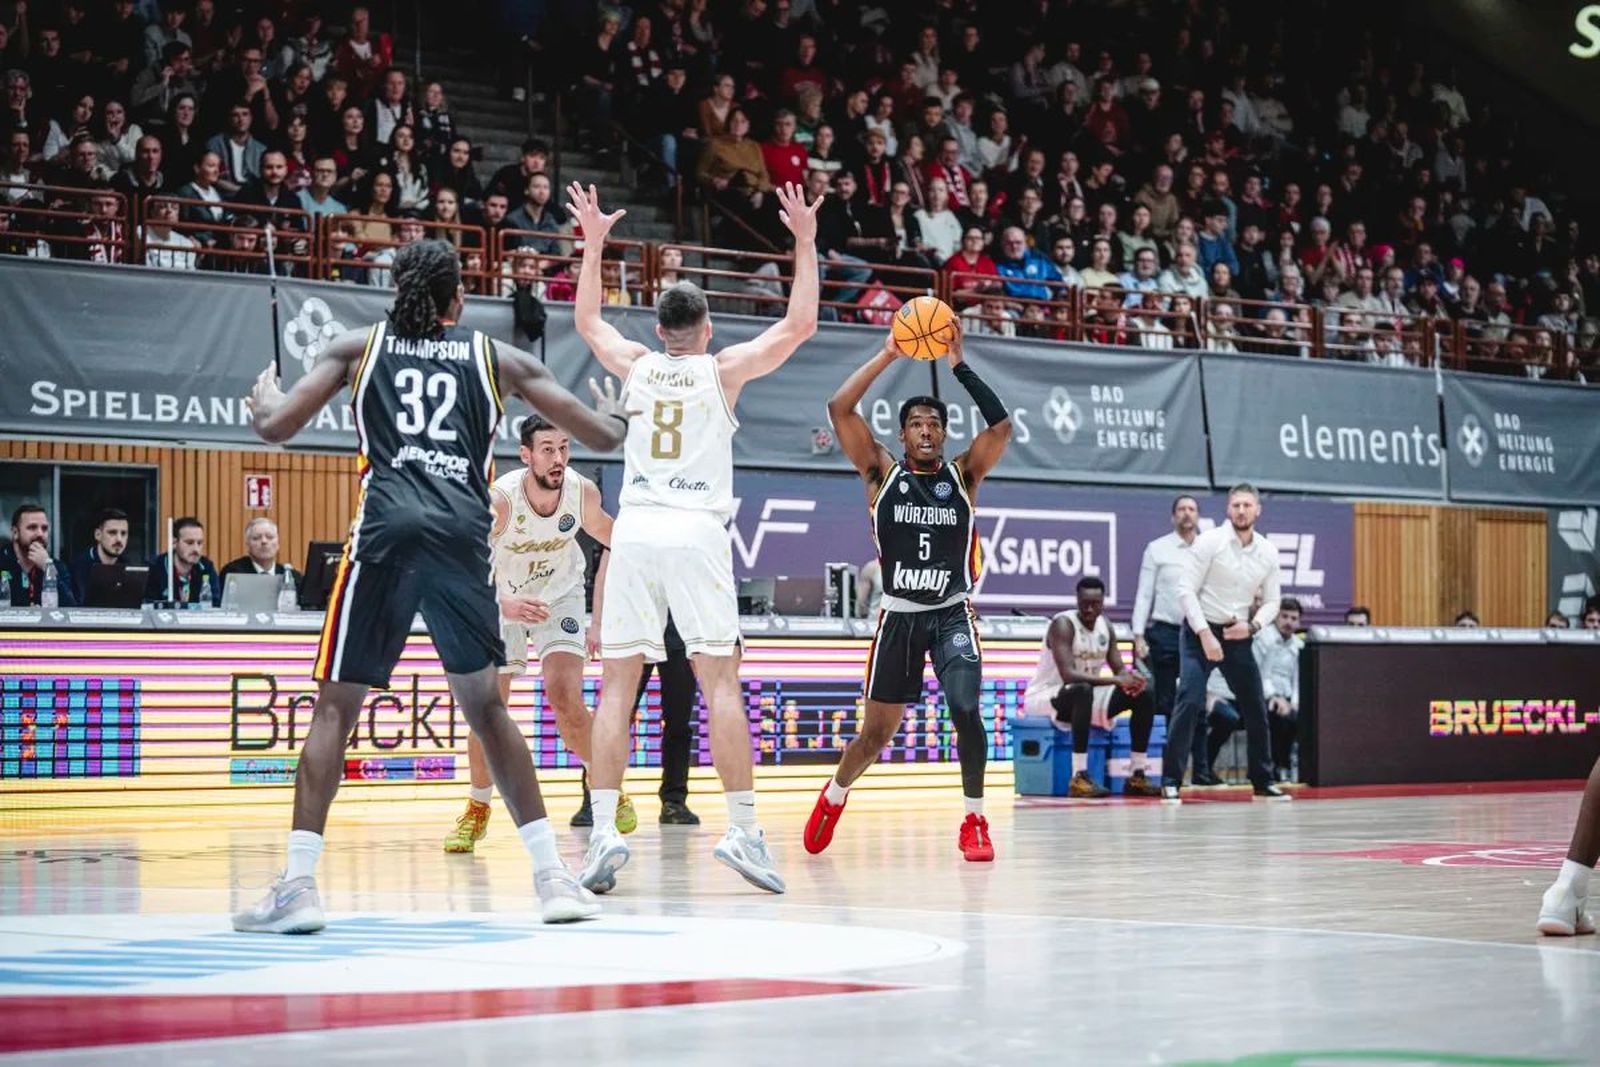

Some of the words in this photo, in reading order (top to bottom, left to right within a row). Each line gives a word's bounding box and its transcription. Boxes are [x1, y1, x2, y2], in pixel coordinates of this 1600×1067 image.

[386, 335, 470, 361] THOMPSON
[394, 367, 457, 441] 32
[1090, 384, 1124, 403] BAD
[1093, 407, 1166, 428] HEIZUNG
[1494, 412, 1521, 431] BAD
[651, 400, 684, 459] 8
[1096, 429, 1166, 450] ENERGIE
[1279, 414, 1442, 467] elements
[1497, 432, 1555, 454] HEIZUNG
[1498, 453, 1556, 474] ENERGIE
[894, 503, 957, 526] WÜRZBURG
[918, 532, 931, 561] 5
